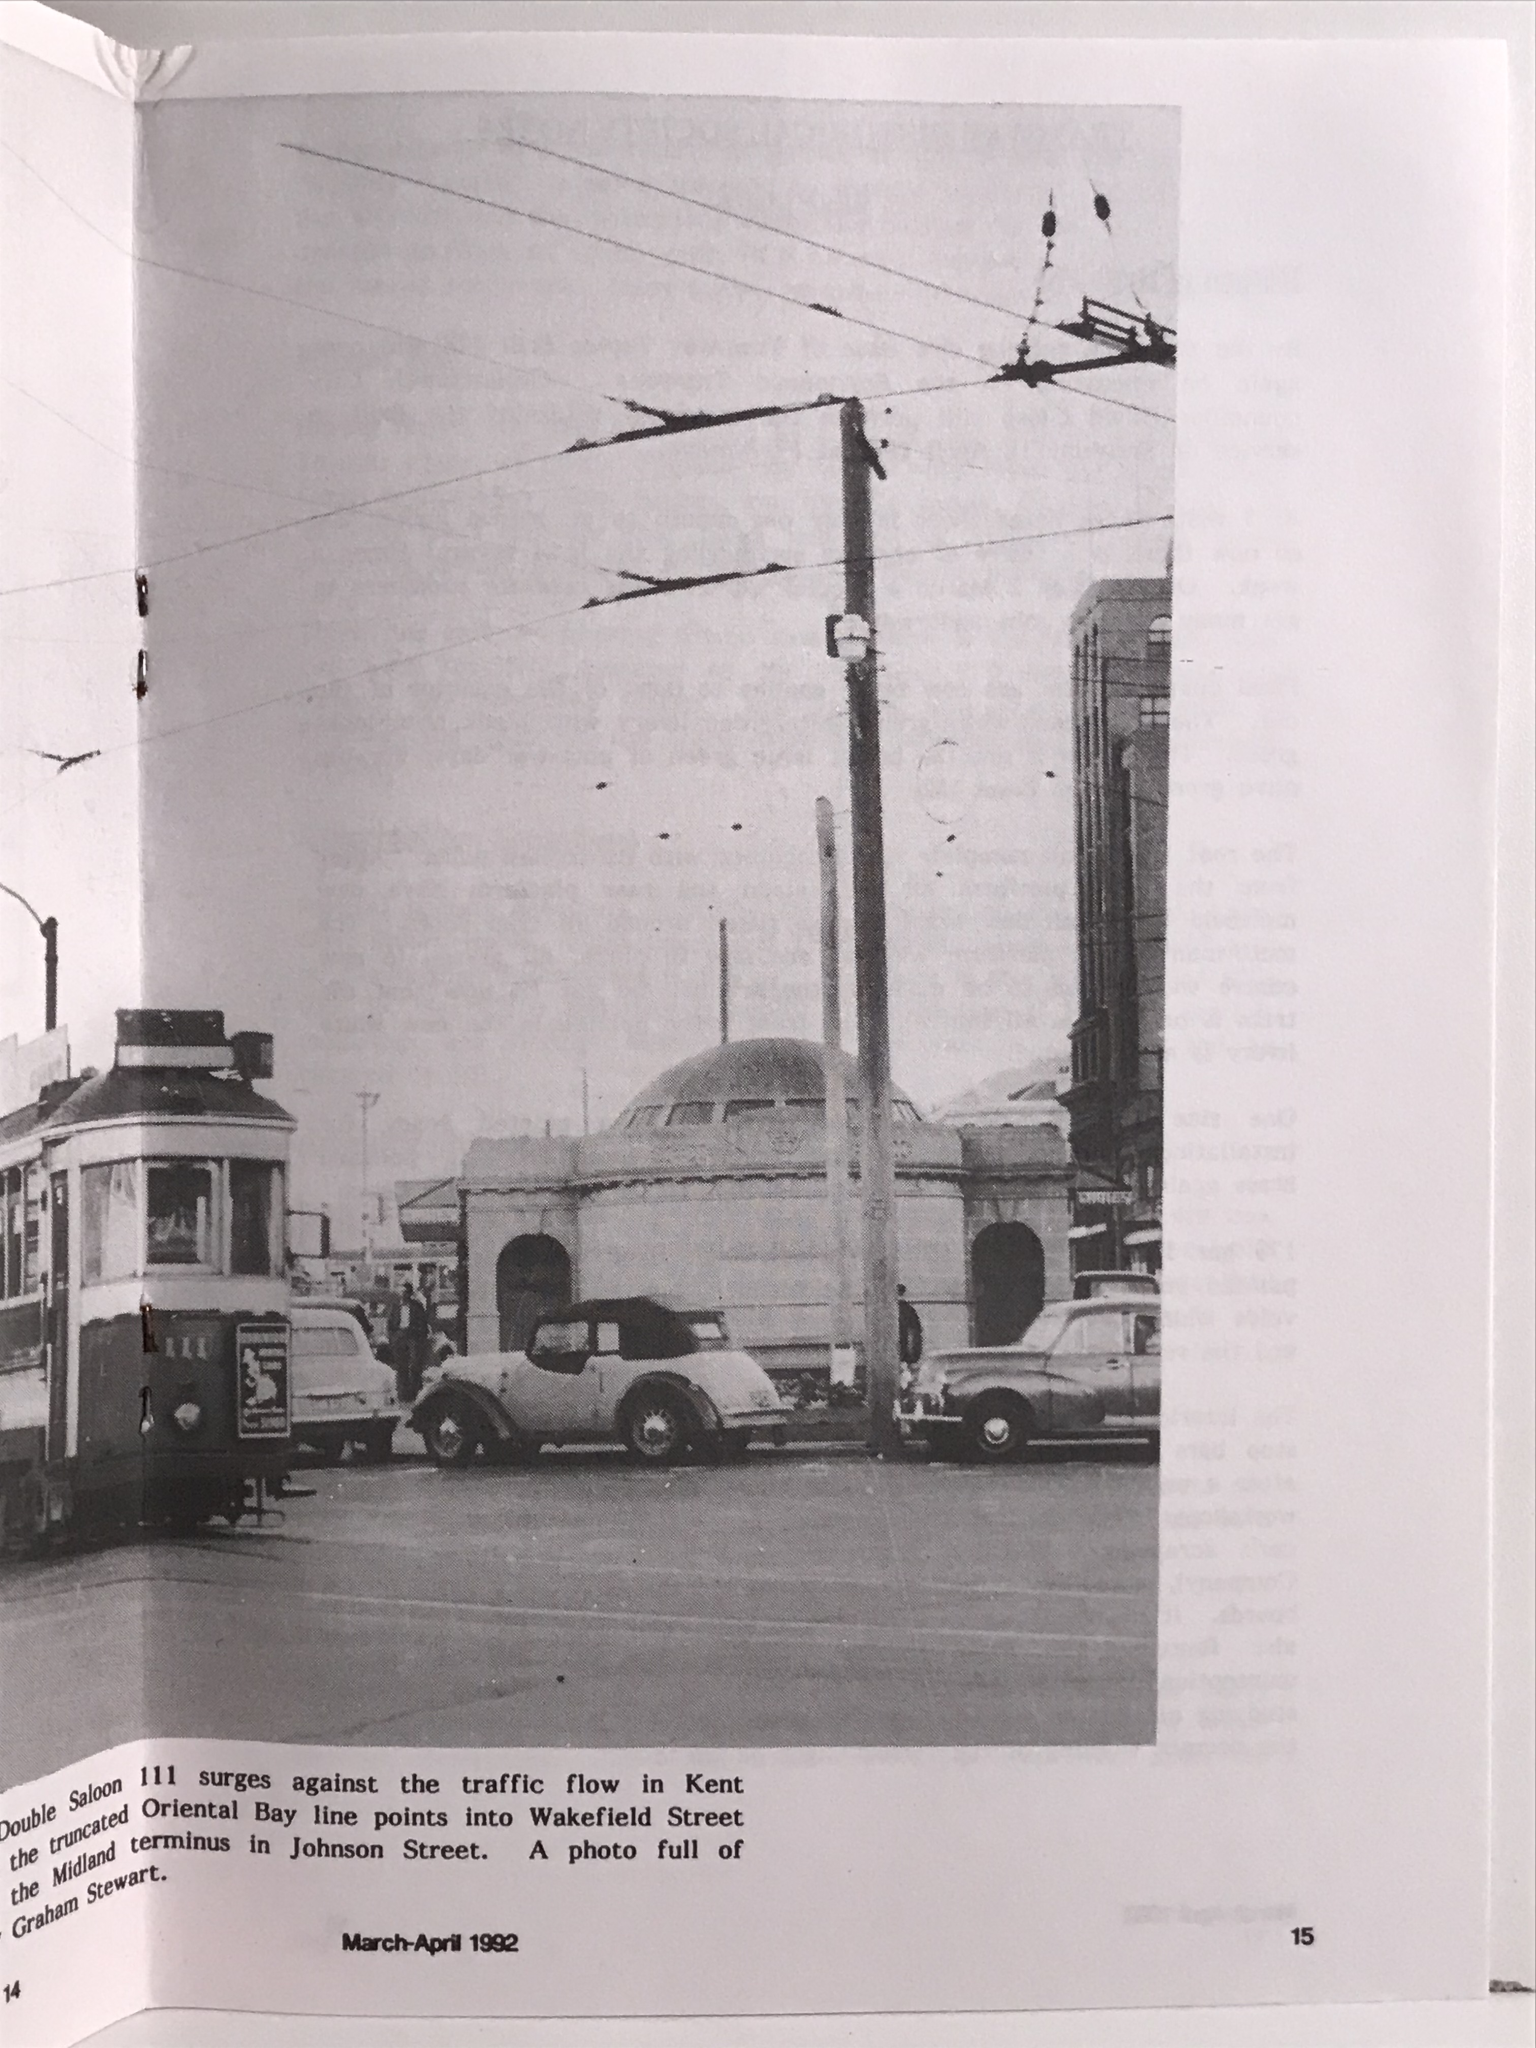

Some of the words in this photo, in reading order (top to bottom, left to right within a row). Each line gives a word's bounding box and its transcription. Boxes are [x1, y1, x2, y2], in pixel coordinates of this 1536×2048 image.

[0, 1803, 57, 1842] Double
[69, 1776, 123, 1813] Saloon
[140, 1764, 177, 1787] 111
[198, 1770, 272, 1793] surges
[292, 1772, 379, 1797] against
[400, 1772, 440, 1794] the
[461, 1773, 545, 1795] traffic
[566, 1773, 620, 1794] flow
[642, 1773, 664, 1794] in
[685, 1773, 745, 1794] Kent
[9, 1847, 39, 1872] the
[49, 1804, 129, 1855] truncated
[141, 1797, 239, 1820] Oriental
[254, 1801, 298, 1828] Bay
[313, 1804, 359, 1827] line
[374, 1806, 448, 1831] points
[465, 1806, 514, 1827] into
[529, 1806, 652, 1828] Wakefield
[667, 1805, 745, 1827] Street
[10, 1881, 40, 1906] the
[52, 1841, 117, 1889] Midland
[130, 1830, 231, 1854] terminus
[249, 1833, 271, 1855] in
[289, 1836, 384, 1860] Johnson
[403, 1838, 488, 1860] Street.
[528, 1839, 549, 1860] A
[568, 1839, 637, 1865] photo
[657, 1838, 699, 1860] full
[718, 1838, 745, 1860] of
[11, 1897, 79, 1940] Graham
[86, 1864, 168, 1904] Stewart.
[341, 1932, 462, 1957] March-April
[469, 1932, 519, 1953] 1992
[1290, 1926, 1315, 1946] 15
[3, 1980, 21, 2003] 14
